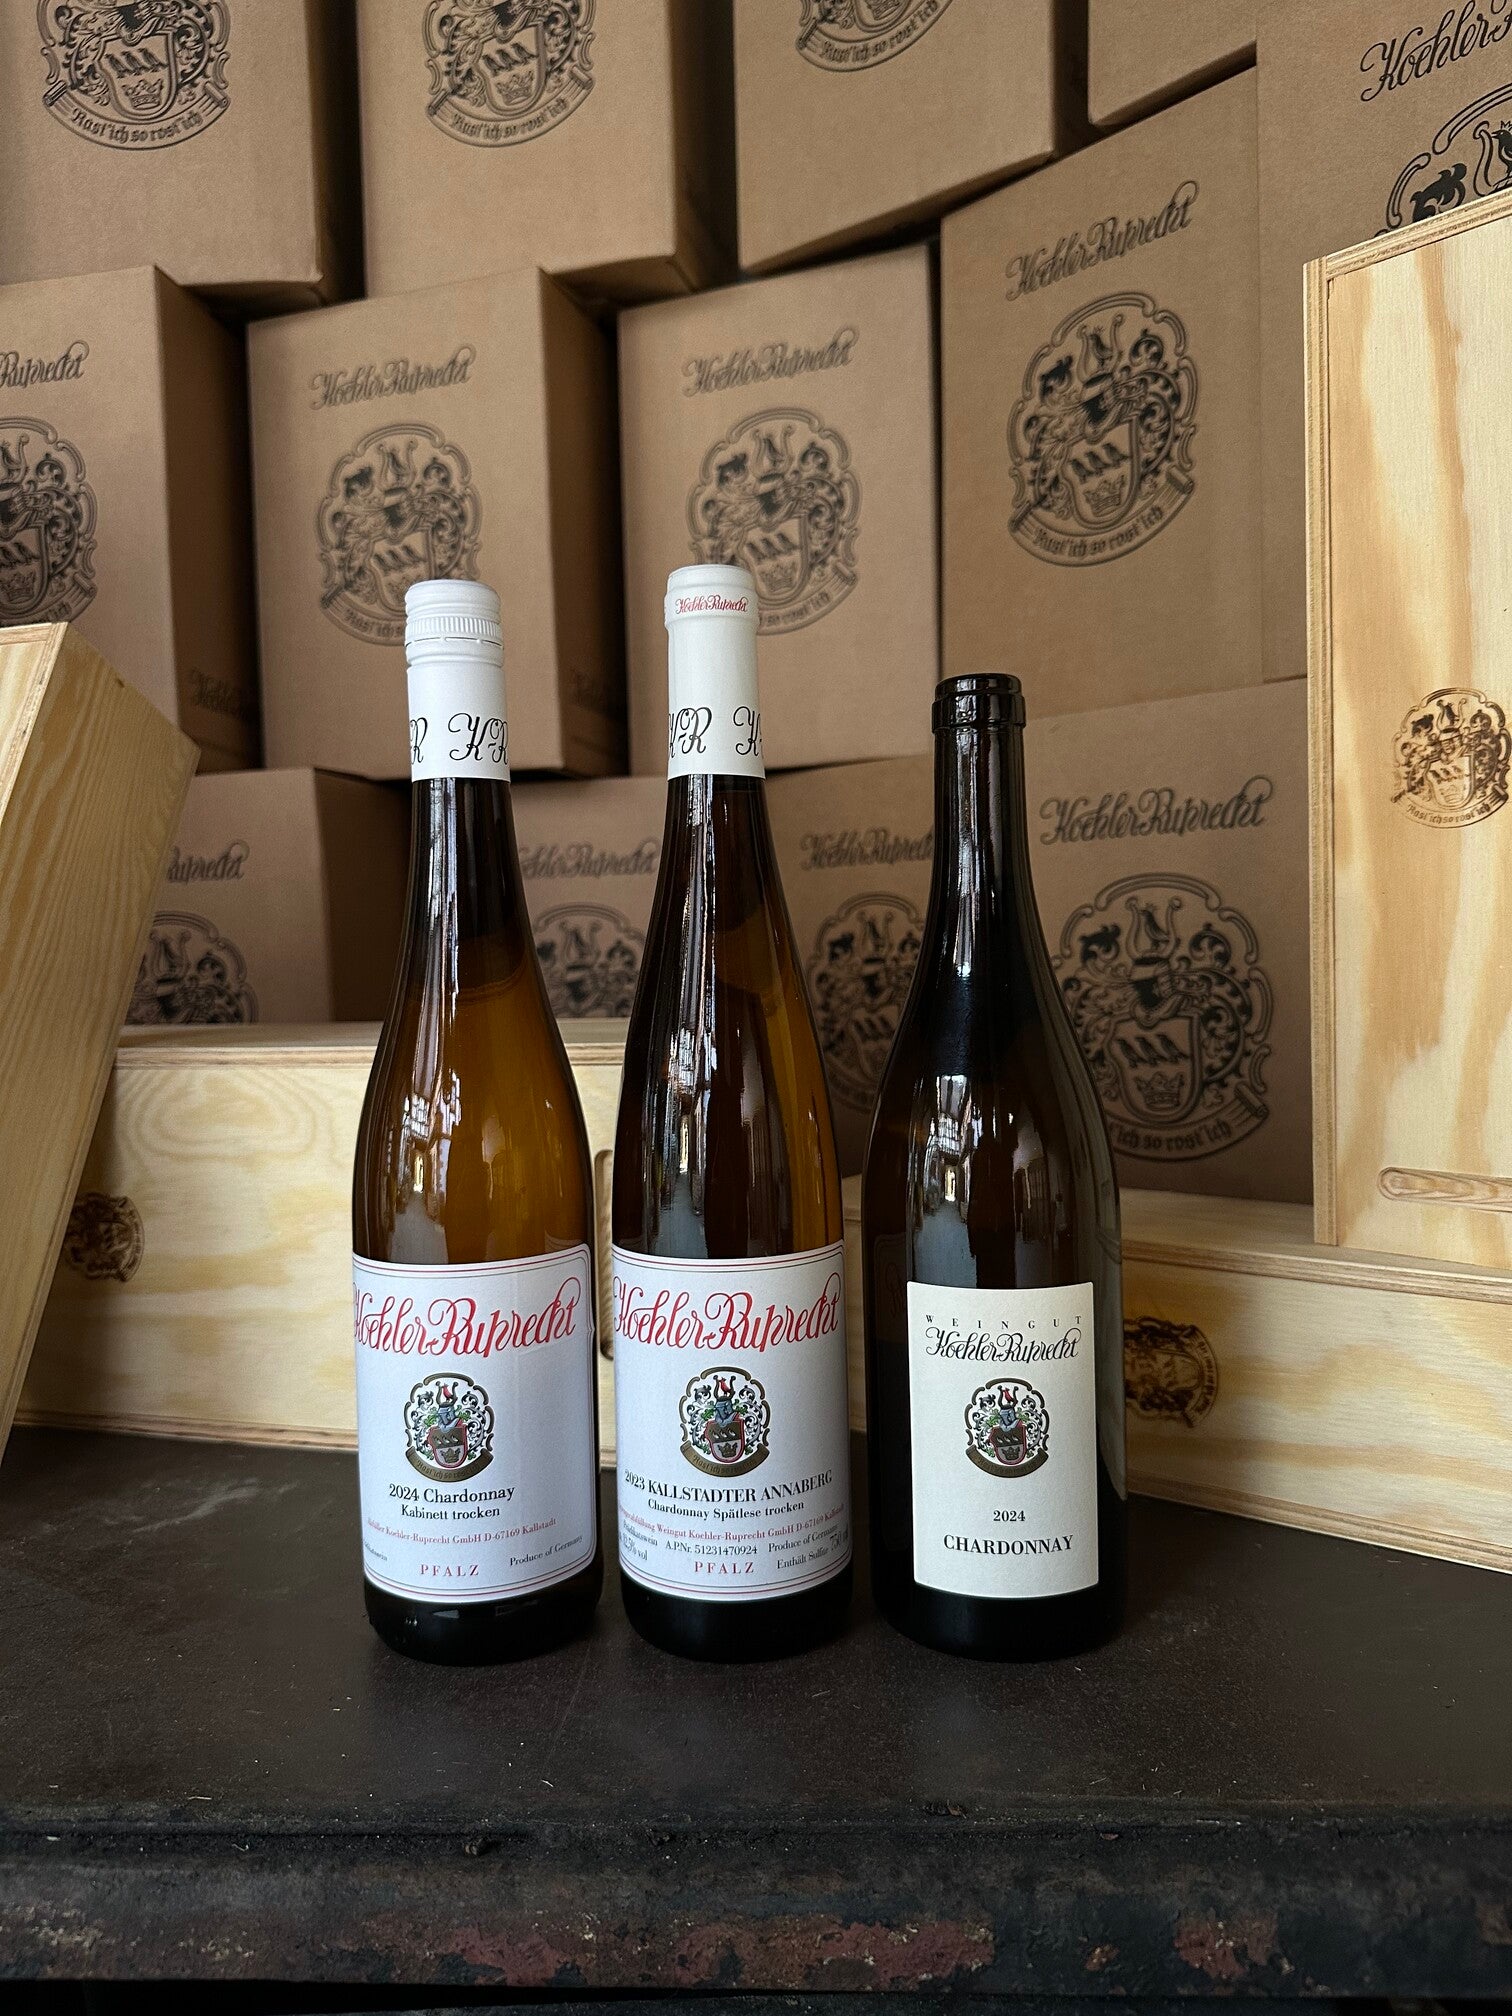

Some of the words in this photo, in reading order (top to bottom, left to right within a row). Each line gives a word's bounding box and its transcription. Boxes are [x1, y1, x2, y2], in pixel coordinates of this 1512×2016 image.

[389, 1483, 419, 1501] 2024
[423, 1486, 515, 1504] Chardonnay
[624, 1468, 645, 1490] 2023
[648, 1479, 756, 1503] KALLSTADTER
[761, 1469, 832, 1501] ANNABERG
[401, 1503, 448, 1520] Kabinett
[453, 1506, 500, 1520] trocken
[648, 1498, 709, 1520] Chardonnay
[713, 1507, 760, 1522] Spätlese
[765, 1501, 804, 1516] trocken
[993, 1510, 1026, 1522] 2024
[452, 1534, 481, 1544] GmbH
[522, 1518, 556, 1536] Kallstadt
[657, 1523, 686, 1538] Weingut
[688, 1529, 765, 1543] Koehler-Ruprecht
[767, 1523, 794, 1537] GmbH
[768, 1540, 801, 1553] Produce
[802, 1533, 811, 1545] of
[943, 1534, 1074, 1556] CHARDONNAY
[510, 1553, 543, 1566] Produce
[545, 1547, 553, 1557] of
